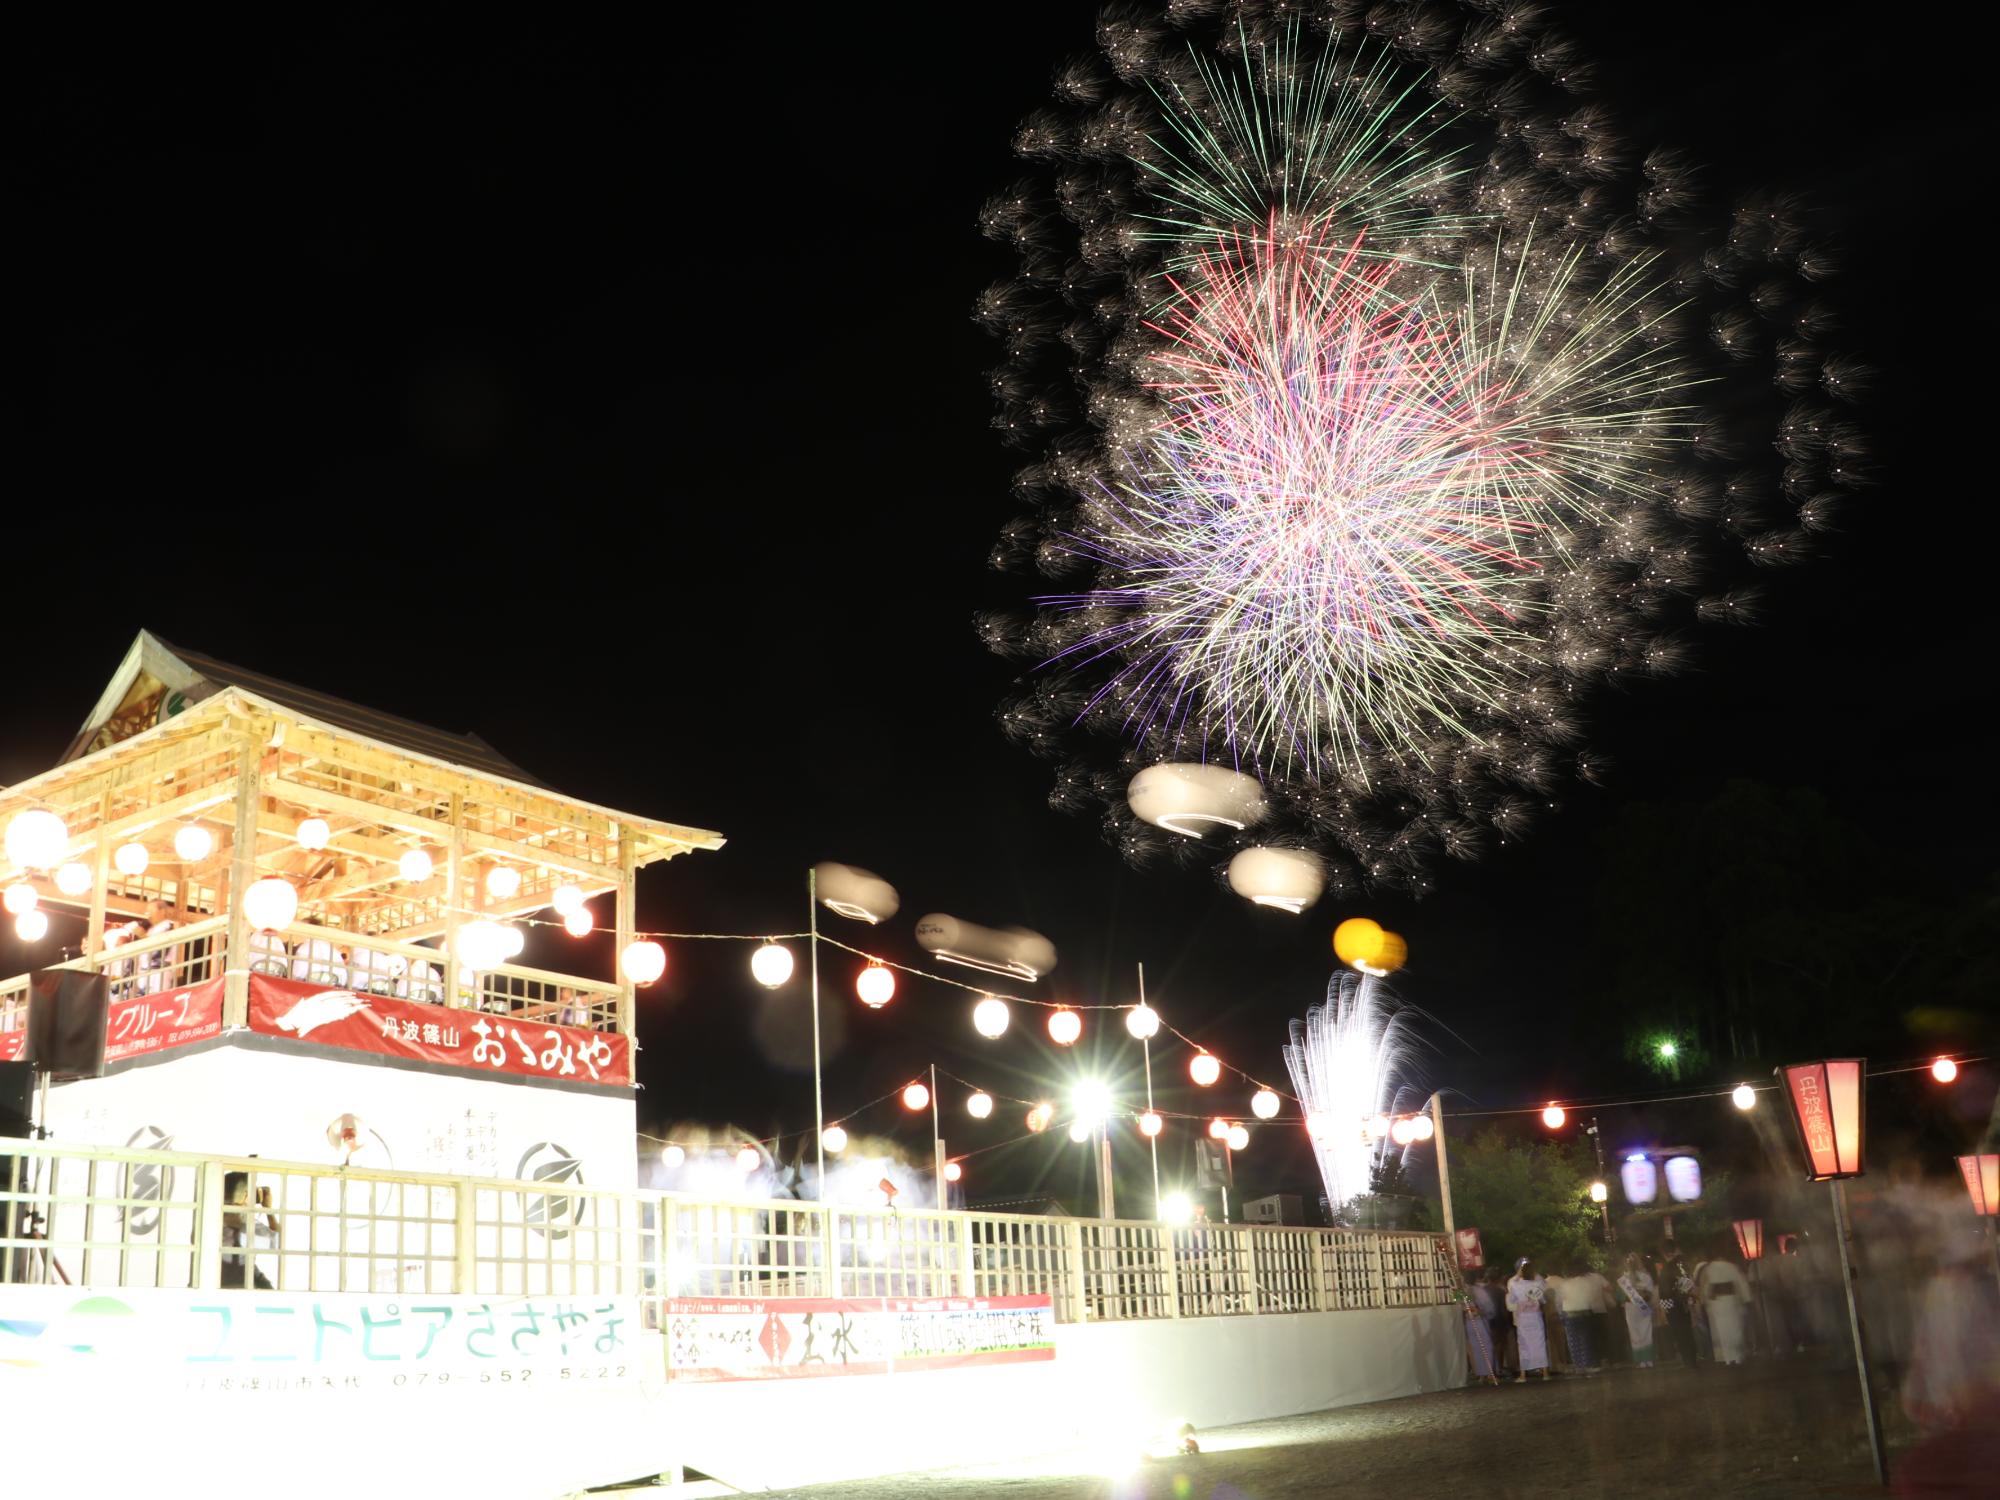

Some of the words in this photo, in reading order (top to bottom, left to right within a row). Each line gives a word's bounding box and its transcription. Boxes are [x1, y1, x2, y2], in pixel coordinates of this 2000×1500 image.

[107, 991, 192, 1040] グループ
[382, 1016, 460, 1048] 丹波篠山
[1800, 1076, 1831, 1153] 丹波篠山
[186, 1303, 626, 1363] ユニトピアささやま
